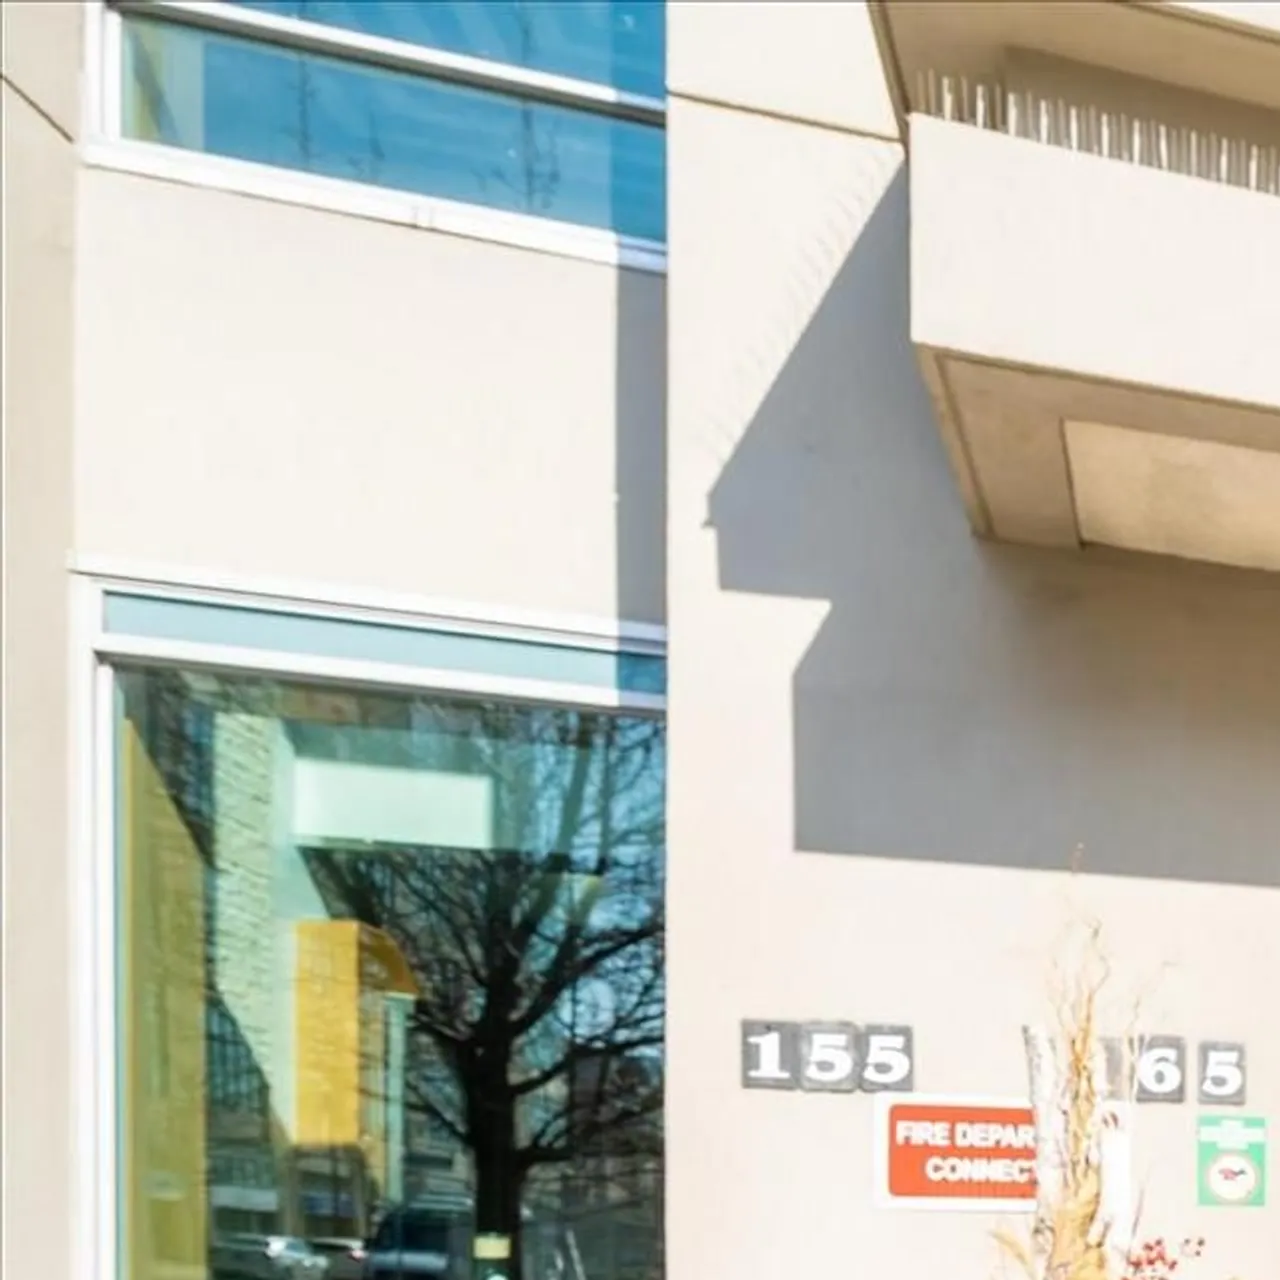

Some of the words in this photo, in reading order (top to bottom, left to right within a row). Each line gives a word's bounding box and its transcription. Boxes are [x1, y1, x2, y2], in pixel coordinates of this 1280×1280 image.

[747, 1030, 911, 1084] 155
[1136, 1046, 1243, 1096] 65
[895, 1120, 951, 1146] FIRE
[954, 1121, 1036, 1148] DEPAR
[926, 1155, 1037, 1182] CONNEC
